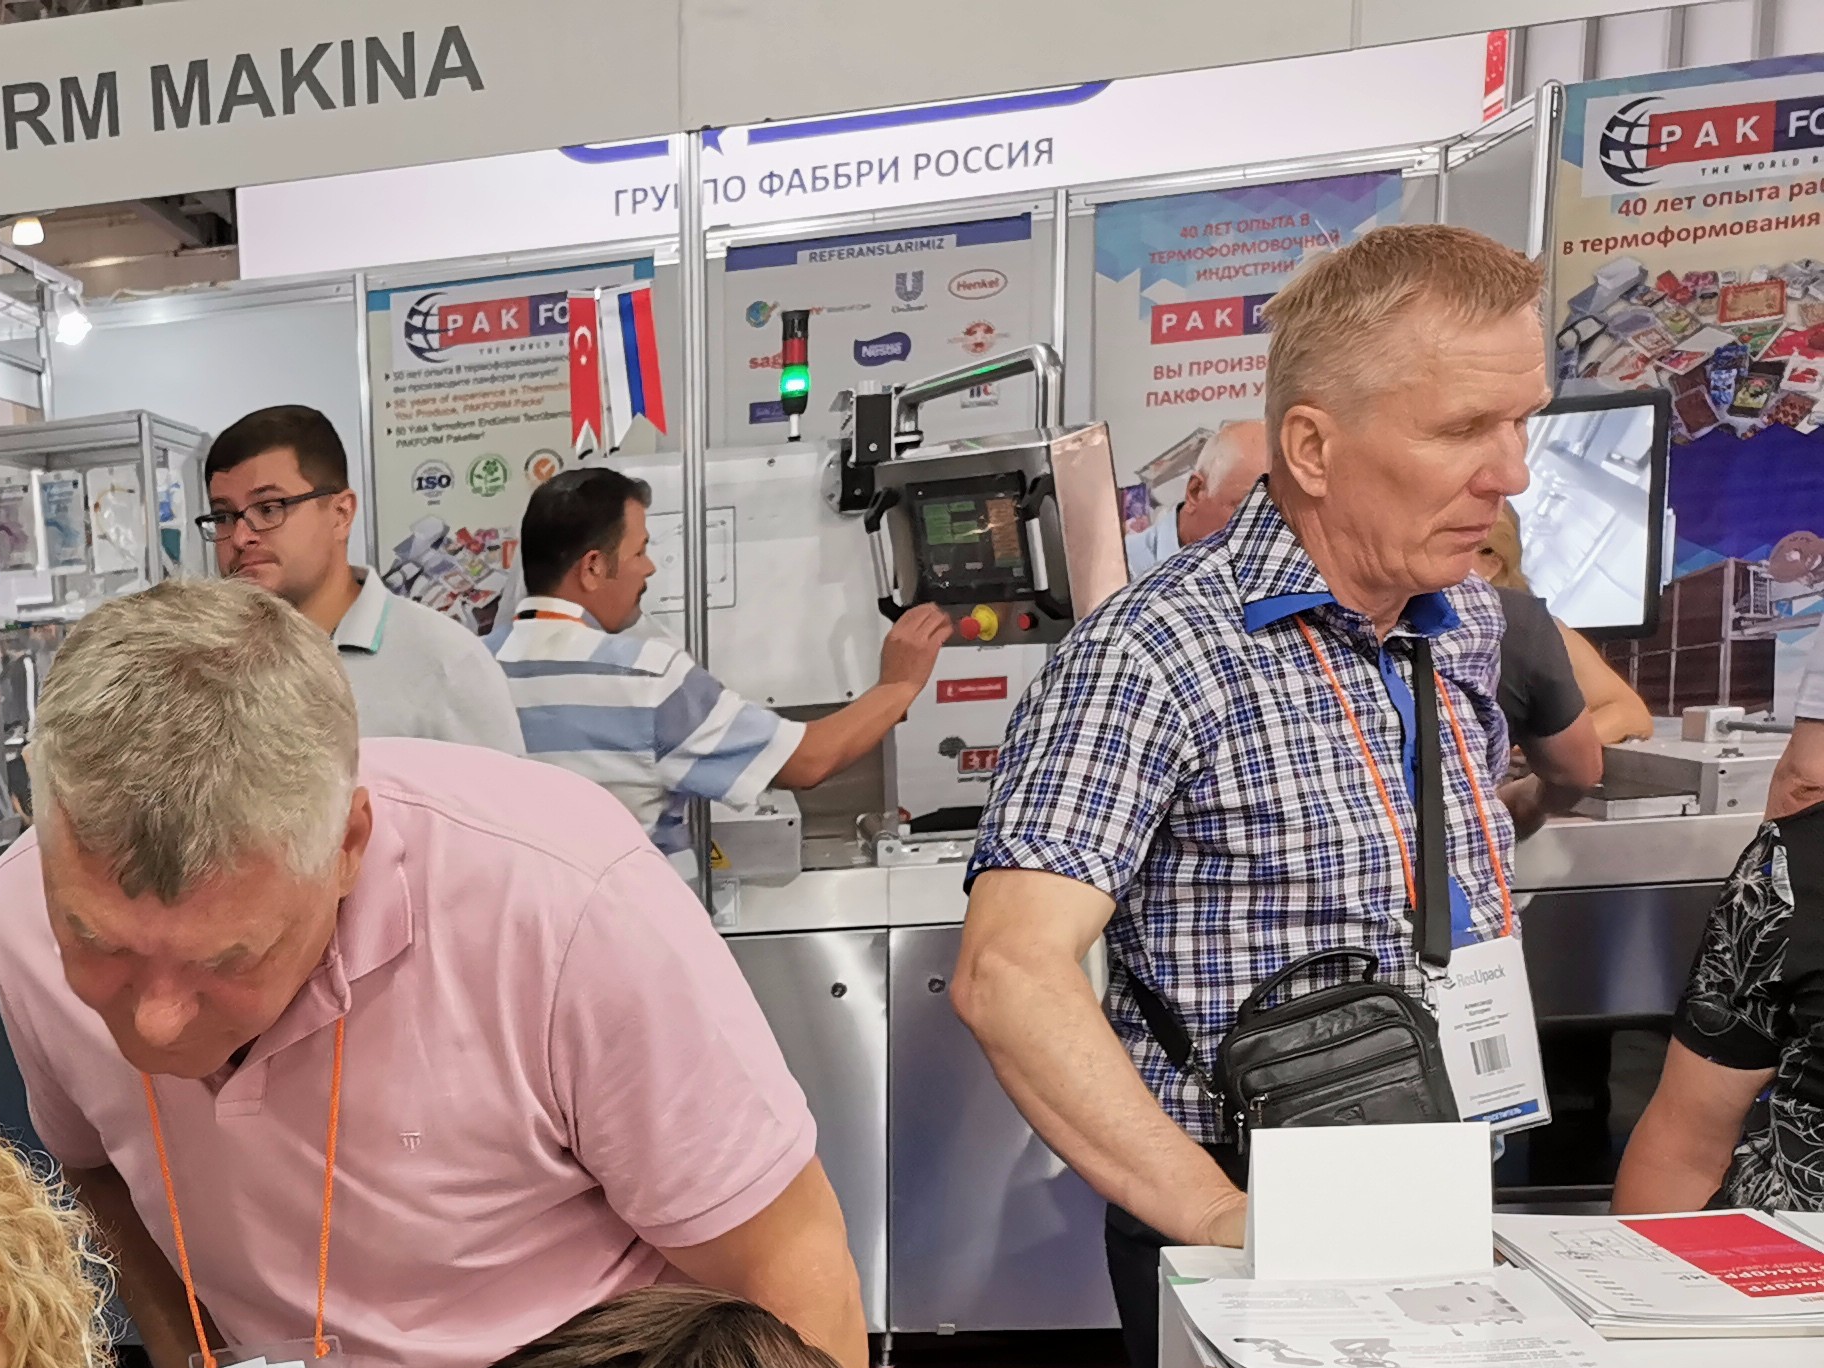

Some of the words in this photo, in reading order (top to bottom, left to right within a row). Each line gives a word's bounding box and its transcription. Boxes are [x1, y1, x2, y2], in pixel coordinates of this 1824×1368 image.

[150, 25, 485, 132] MAKINA
[758, 156, 901, 199] ФАББРИ
[914, 137, 1055, 182] РОССИЯ
[1617, 197, 1648, 218] 40
[1653, 194, 1697, 215] лет
[1702, 185, 1781, 209] опыта
[1179, 225, 1199, 240] 40
[1203, 221, 1233, 238] ЛЕТ
[1236, 214, 1296, 235] ОПЫТА
[1580, 211, 1821, 255] термоформования
[808, 238, 946, 264] REFERANSLARIMIZ
[1148, 229, 1341, 265] ТЕРМОФОРМОВОЧНОЙ
[1152, 363, 1183, 381] ВЫ
[1145, 382, 1247, 408] ПАКФОРМ
[415, 473, 452, 492] ISO
